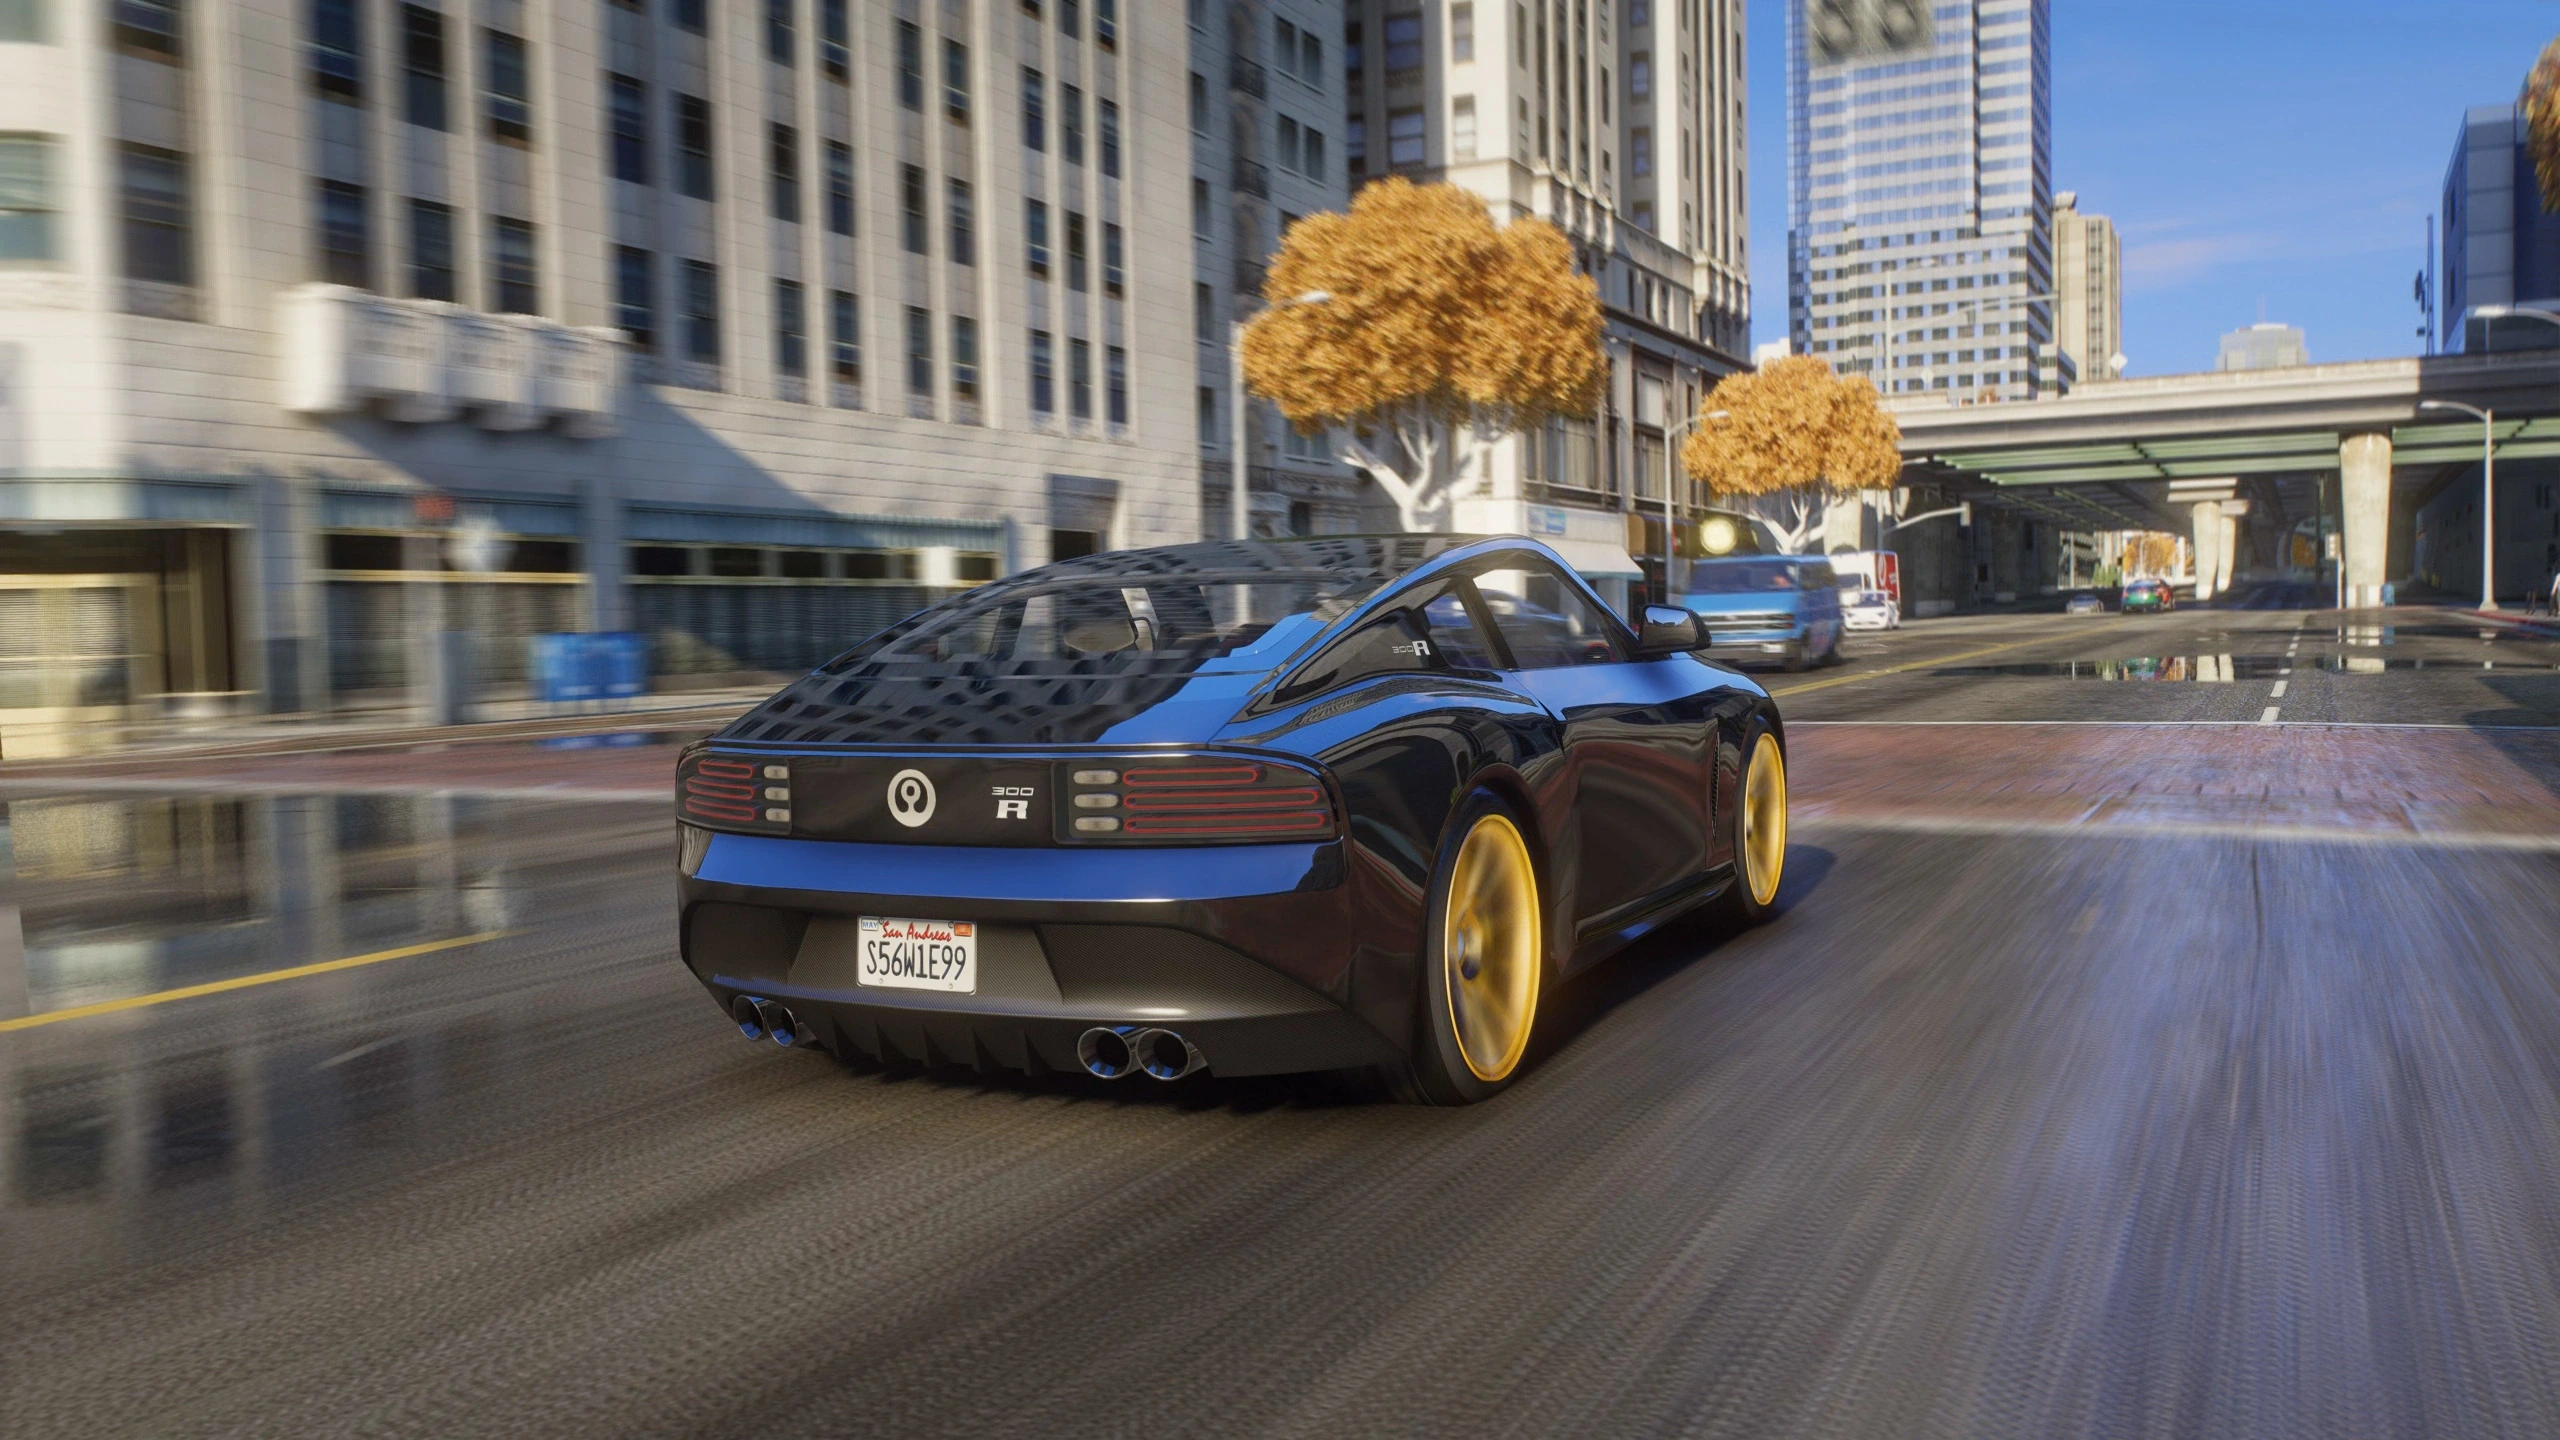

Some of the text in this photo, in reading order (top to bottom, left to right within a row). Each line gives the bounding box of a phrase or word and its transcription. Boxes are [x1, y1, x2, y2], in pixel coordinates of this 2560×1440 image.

[991, 786, 1035, 797] 300
[995, 799, 1029, 820] R
[862, 920, 878, 929] MAY
[882, 920, 952, 942] San Andreas
[866, 940, 967, 981] S56W1E99
